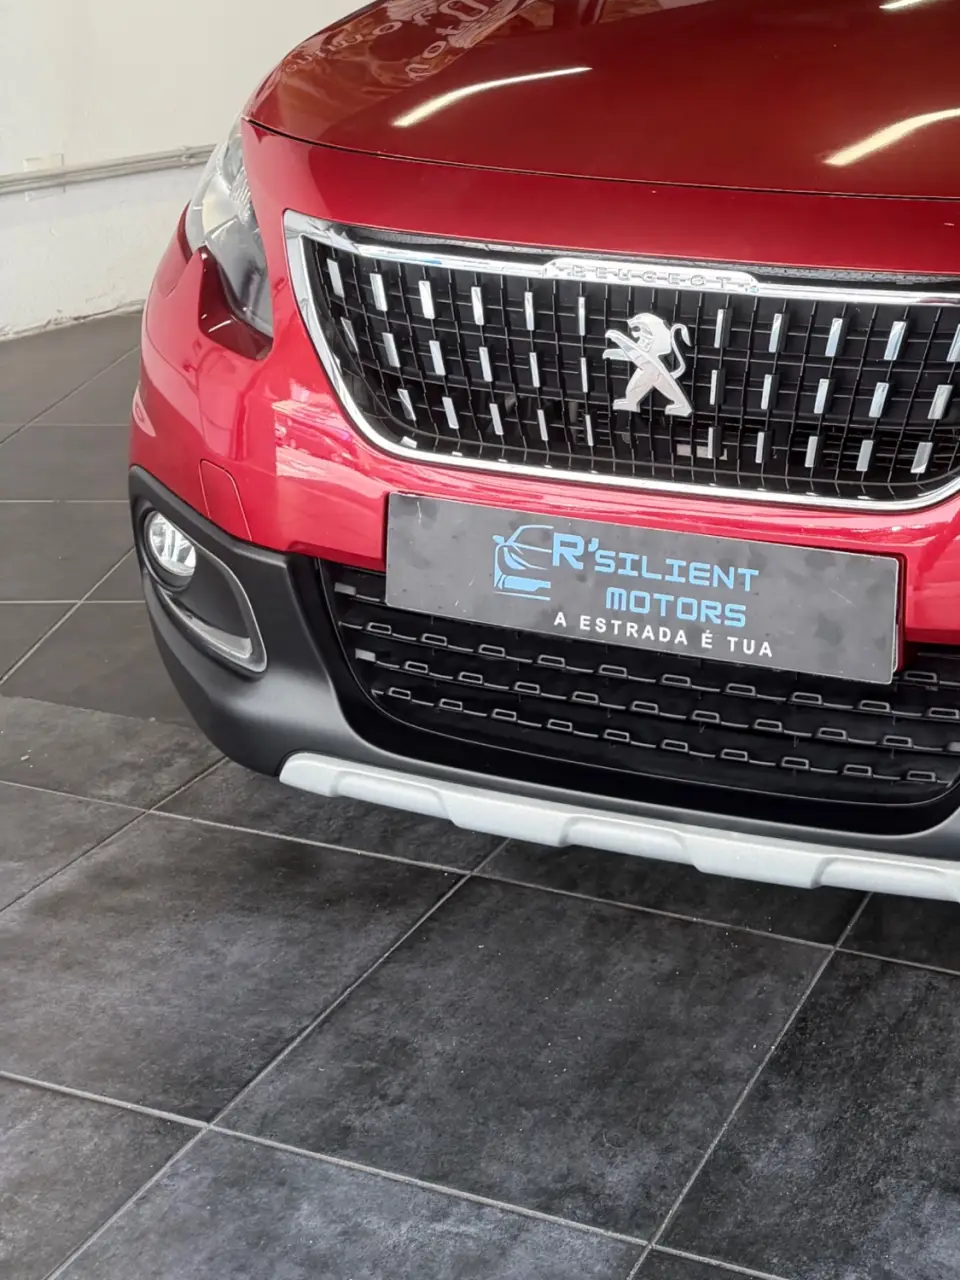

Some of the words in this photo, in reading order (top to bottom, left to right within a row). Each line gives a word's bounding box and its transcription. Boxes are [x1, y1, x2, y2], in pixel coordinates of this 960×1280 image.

[572, 263, 732, 290] PEUGEOT
[605, 587, 747, 628] MOTORS
[553, 612, 567, 627] A
[579, 615, 688, 646] ESTRADA
[701, 628, 713, 649] É
[727, 637, 774, 658] TUA
